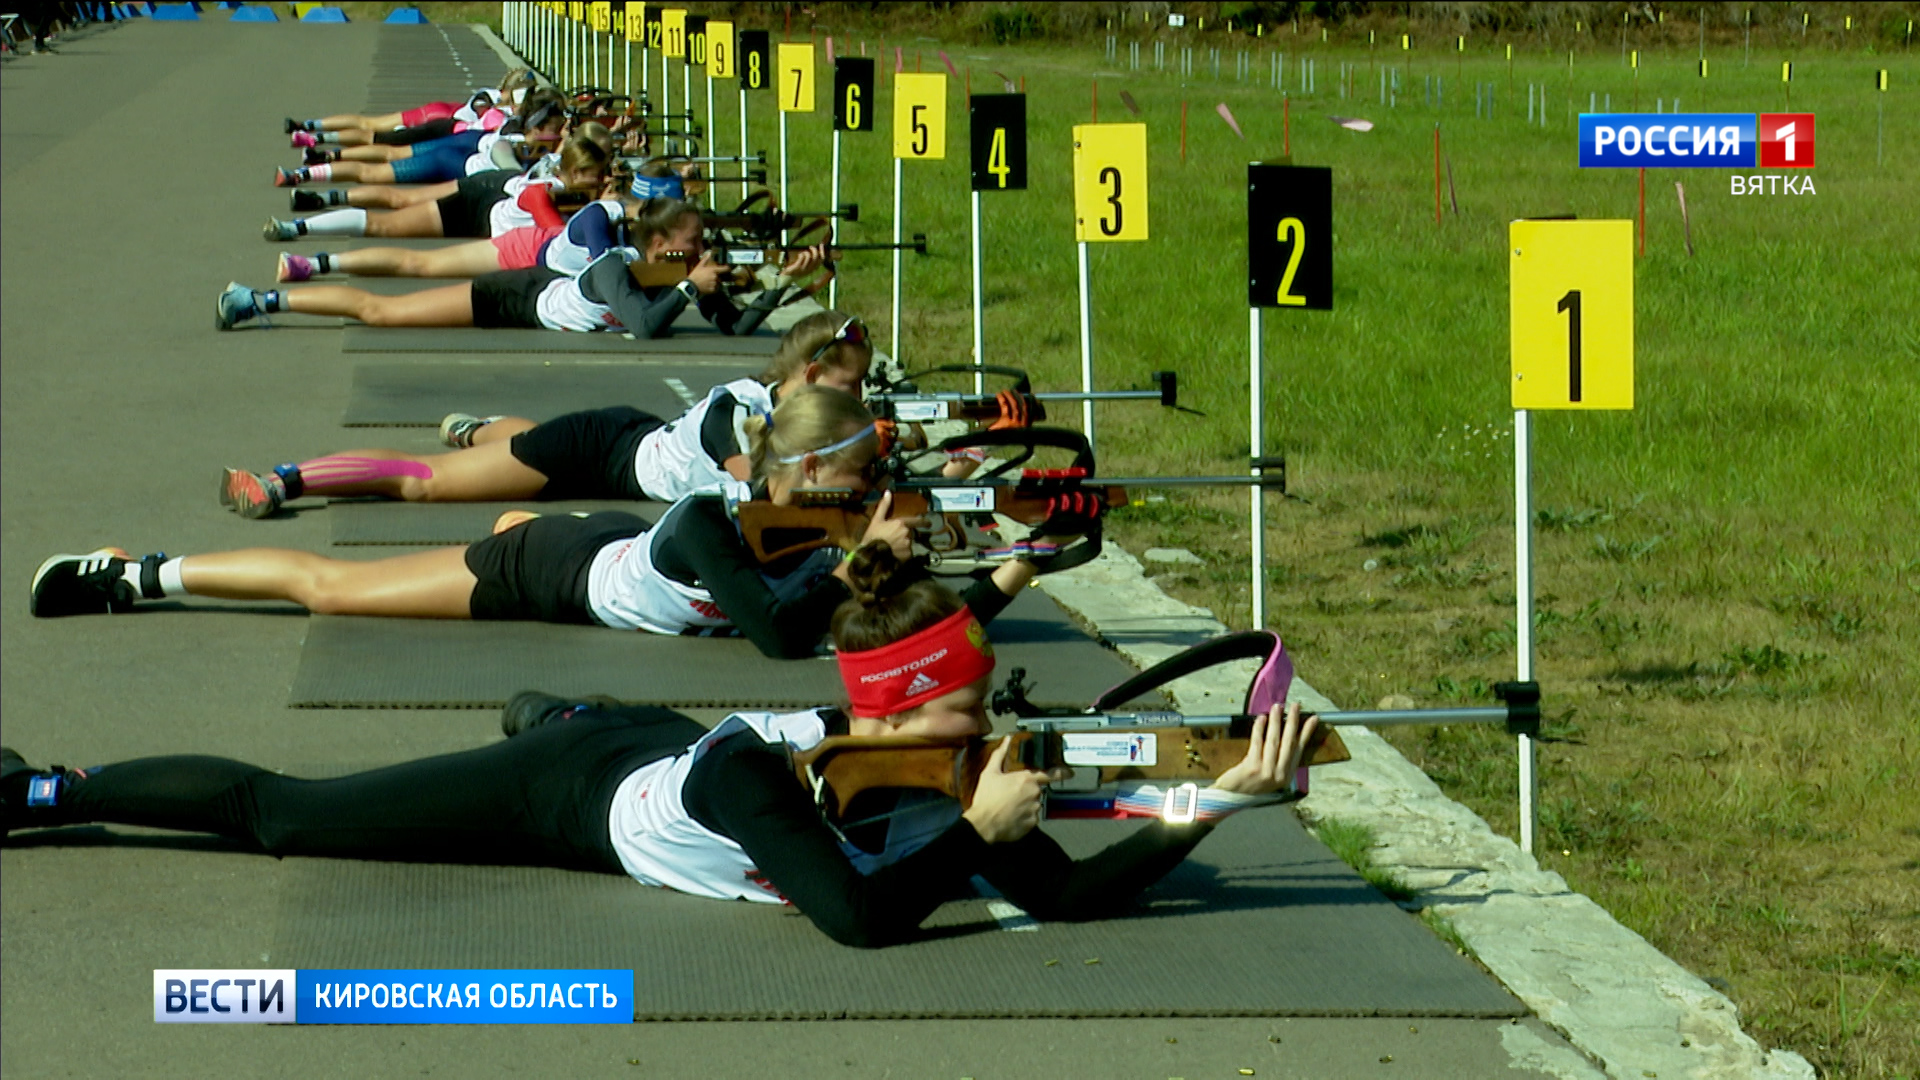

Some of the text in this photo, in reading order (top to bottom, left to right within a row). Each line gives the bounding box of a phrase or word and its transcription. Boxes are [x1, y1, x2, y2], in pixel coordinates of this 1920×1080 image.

[596, 7, 608, 29] 15
[612, 10, 624, 34] 14
[629, 15, 642, 39] 13
[647, 21, 661, 48] 12
[669, 28, 681, 54] 11
[688, 33, 705, 64] 10
[715, 42, 725, 75] 9
[749, 51, 761, 88] 8
[791, 69, 802, 108] 7
[845, 83, 861, 130] 6
[911, 105, 928, 156] 5
[988, 127, 1011, 188] 4
[1099, 166, 1123, 237] 3
[1275, 217, 1307, 307] 2
[1557, 290, 1582, 403] 1
[860, 648, 948, 684] РОСАВТОДОР
